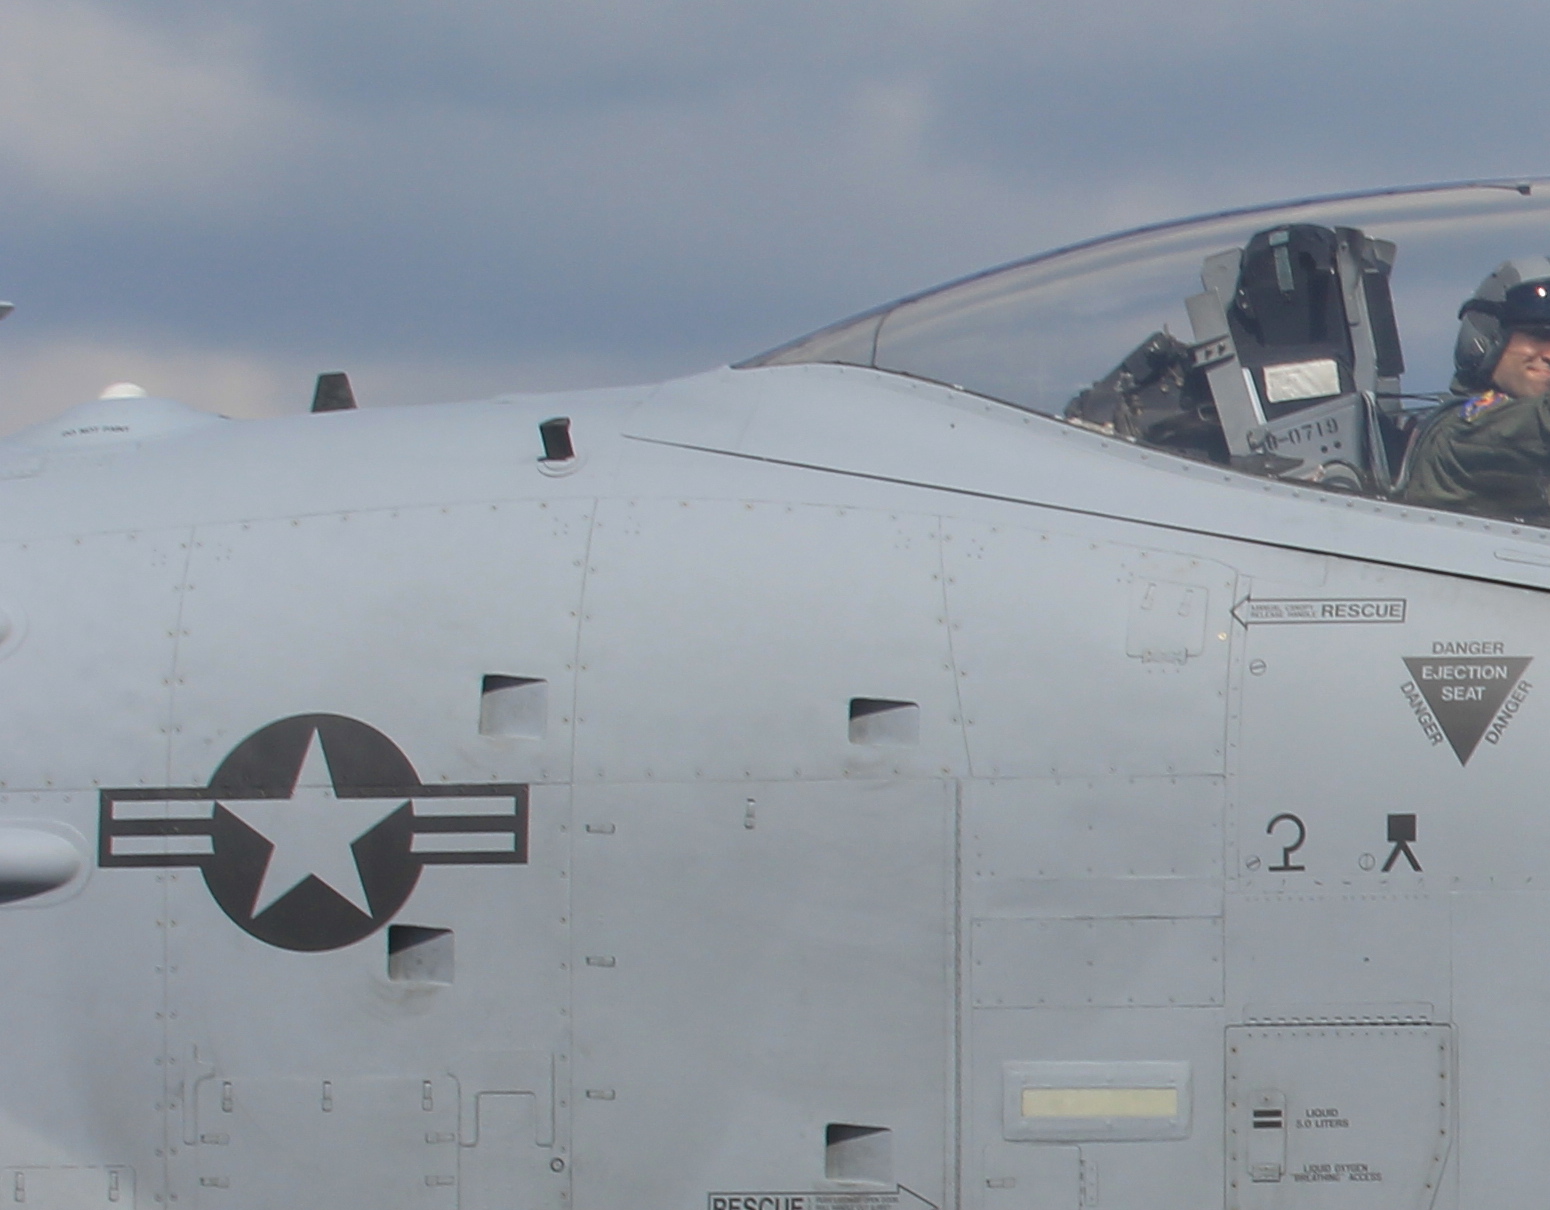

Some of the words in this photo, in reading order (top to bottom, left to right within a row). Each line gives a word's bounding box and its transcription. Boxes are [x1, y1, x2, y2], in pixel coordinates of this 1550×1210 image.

[1321, 603, 1401, 618] RESCUE
[1432, 641, 1505, 655] DANGER
[1421, 665, 1508, 680] EJECTION
[1441, 686, 1487, 701] SEAT
[1400, 681, 1444, 747] DANGER
[1484, 680, 1533, 745] DANGER
[1305, 1108, 1339, 1118] LIQUID
[1315, 1119, 1349, 1128] LITERS
[1303, 1164, 1332, 1173] LIQUID
[1334, 1163, 1368, 1172] OXYGEN
[1349, 1172, 1382, 1181] ACCESS
